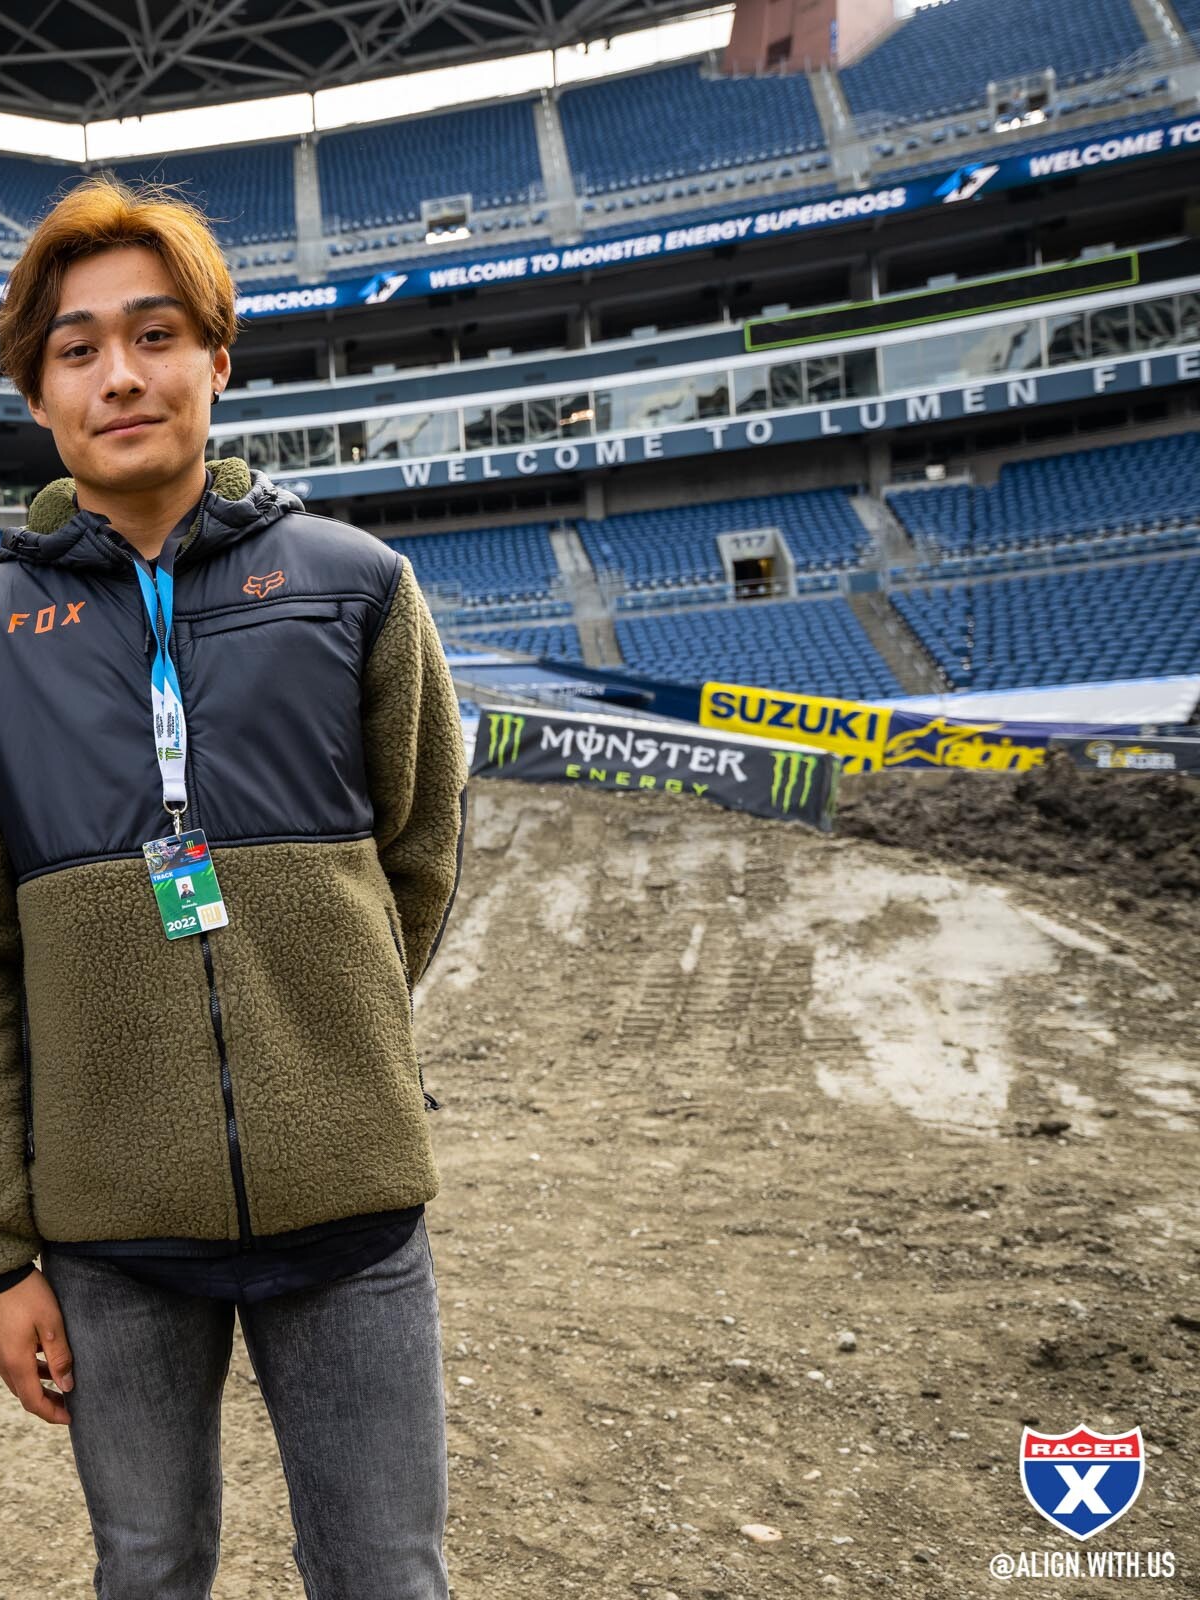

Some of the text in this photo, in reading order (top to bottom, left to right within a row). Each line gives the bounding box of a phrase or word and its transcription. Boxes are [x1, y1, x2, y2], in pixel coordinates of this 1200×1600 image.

[1029, 121, 1200, 177] WELCOME TO
[429, 187, 907, 289] WELCOME TO MONSTER ENERGY SUPERCROSS
[402, 432, 664, 488] WELCOME
[707, 417, 774, 450] TO
[819, 377, 1038, 435] LUMEN
[7, 601, 86, 634] FOX
[709, 690, 879, 743] SUZUKI
[539, 723, 748, 783] MONSTER
[566, 763, 710, 798] ENERGY
[152, 871, 174, 882] TRACK
[166, 916, 197, 932] 2022
